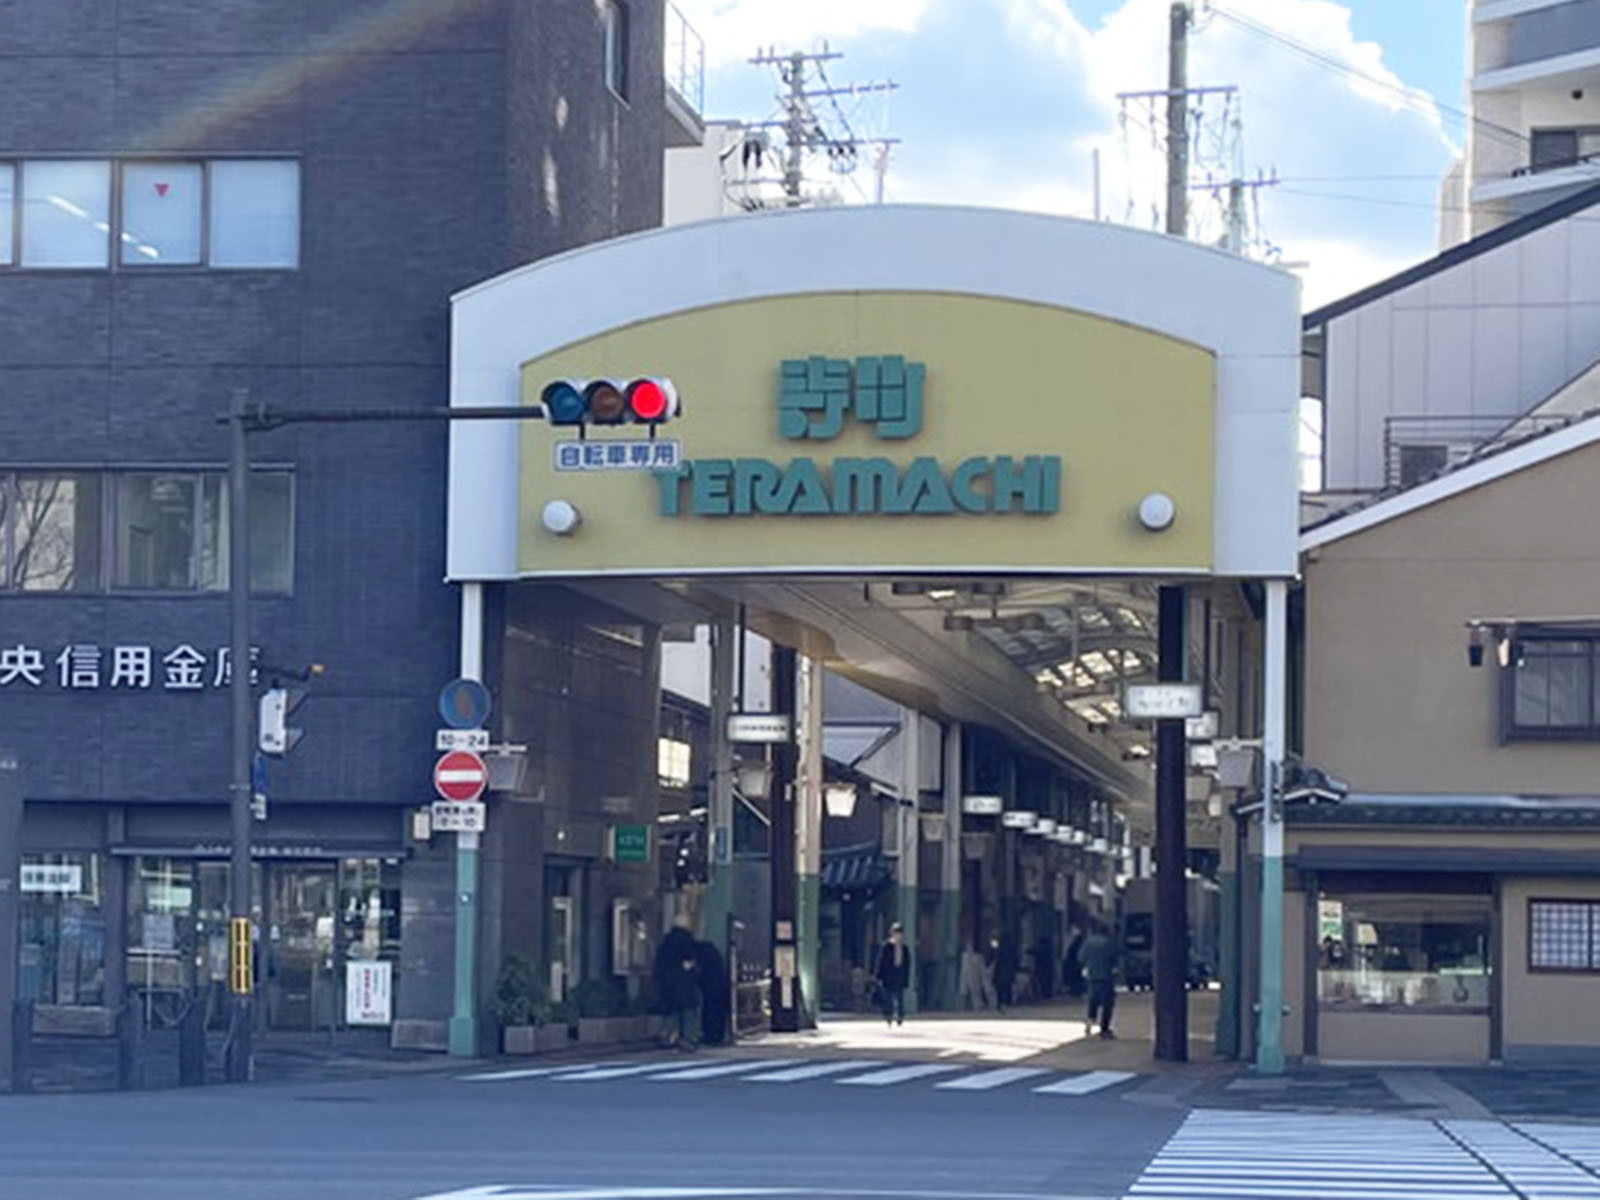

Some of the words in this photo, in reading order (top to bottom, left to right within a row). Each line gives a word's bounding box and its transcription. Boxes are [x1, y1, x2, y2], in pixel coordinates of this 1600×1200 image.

[778, 355, 926, 439] 寺町
[561, 444, 674, 466] 自転車専用
[652, 456, 1062, 516] TERAMACHI
